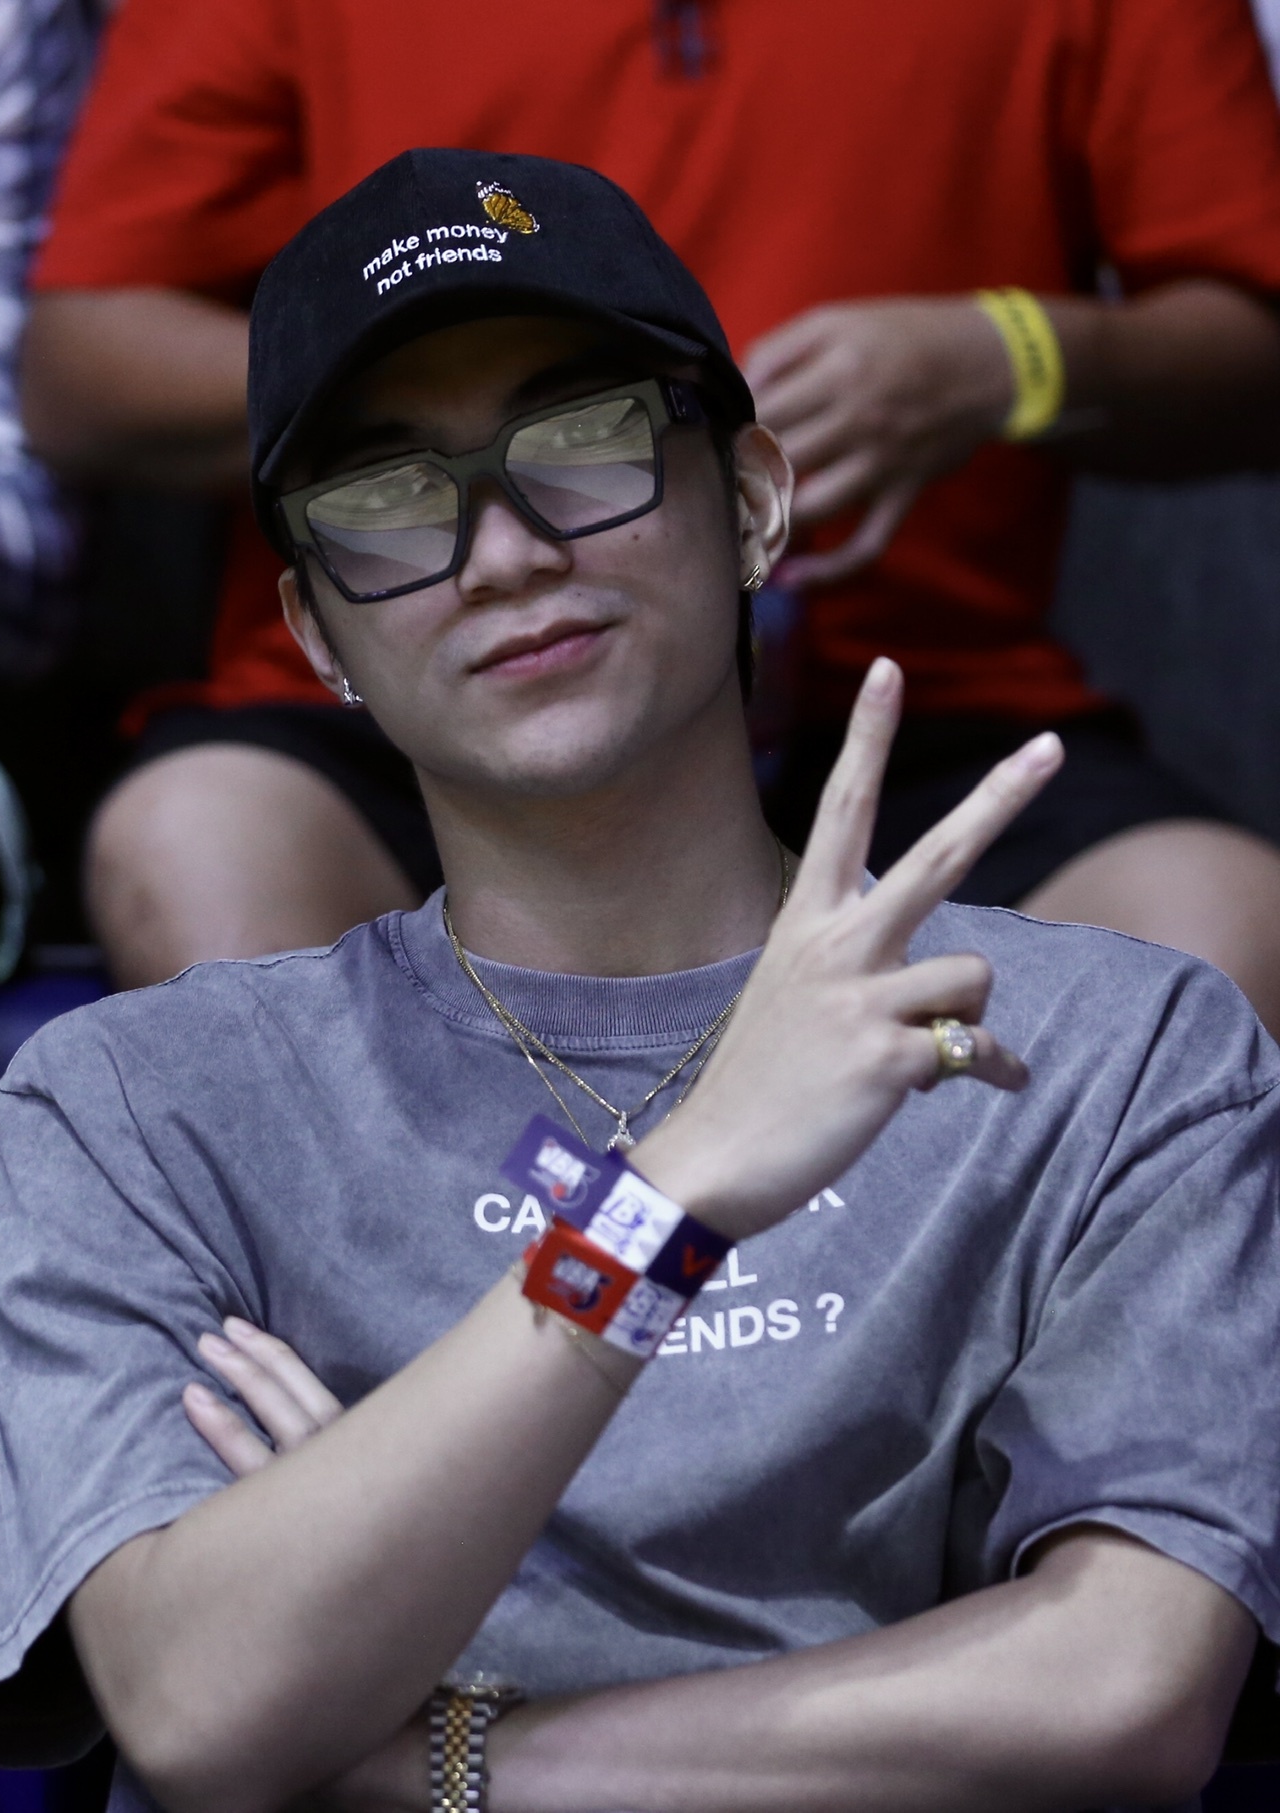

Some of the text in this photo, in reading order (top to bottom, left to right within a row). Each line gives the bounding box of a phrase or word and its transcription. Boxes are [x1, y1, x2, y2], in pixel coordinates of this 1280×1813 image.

[362, 223, 509, 281] make money
[376, 244, 503, 295] not friends
[473, 1193, 547, 1234] CA
[657, 1299, 801, 1355] ENDS
[816, 1292, 845, 1333] ?
